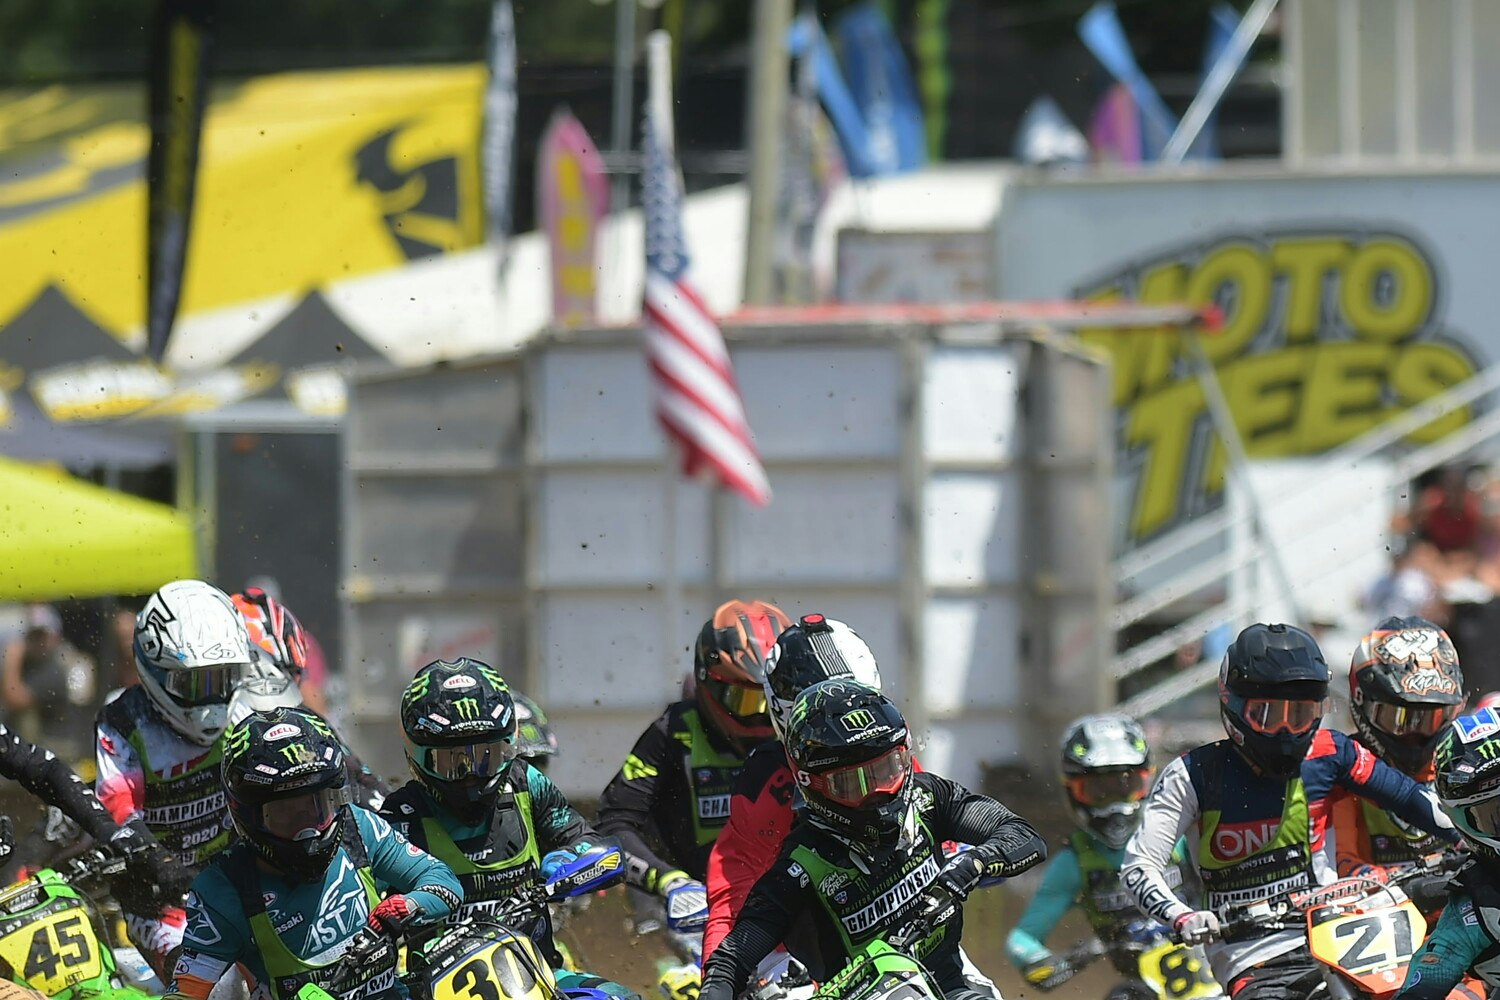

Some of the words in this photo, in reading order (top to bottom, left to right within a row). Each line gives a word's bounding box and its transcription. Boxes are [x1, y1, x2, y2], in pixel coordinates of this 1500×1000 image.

[1080, 237, 1433, 406] MOTO
[1127, 341, 1475, 539] TEES
[448, 678, 472, 687] BELL
[1408, 669, 1452, 691] RACING
[269, 727, 295, 738] BELL
[450, 720, 495, 731] MONSTER
[846, 725, 891, 743] MONSTER
[1470, 725, 1493, 739] BELL
[281, 761, 328, 777] MONSTER
[181, 824, 219, 850] 2020
[1004, 851, 1039, 871] MONSTER
[819, 872, 839, 893] TEAM
[827, 874, 849, 897] GREEN
[24, 916, 91, 981] 45
[1335, 910, 1414, 975] 21
